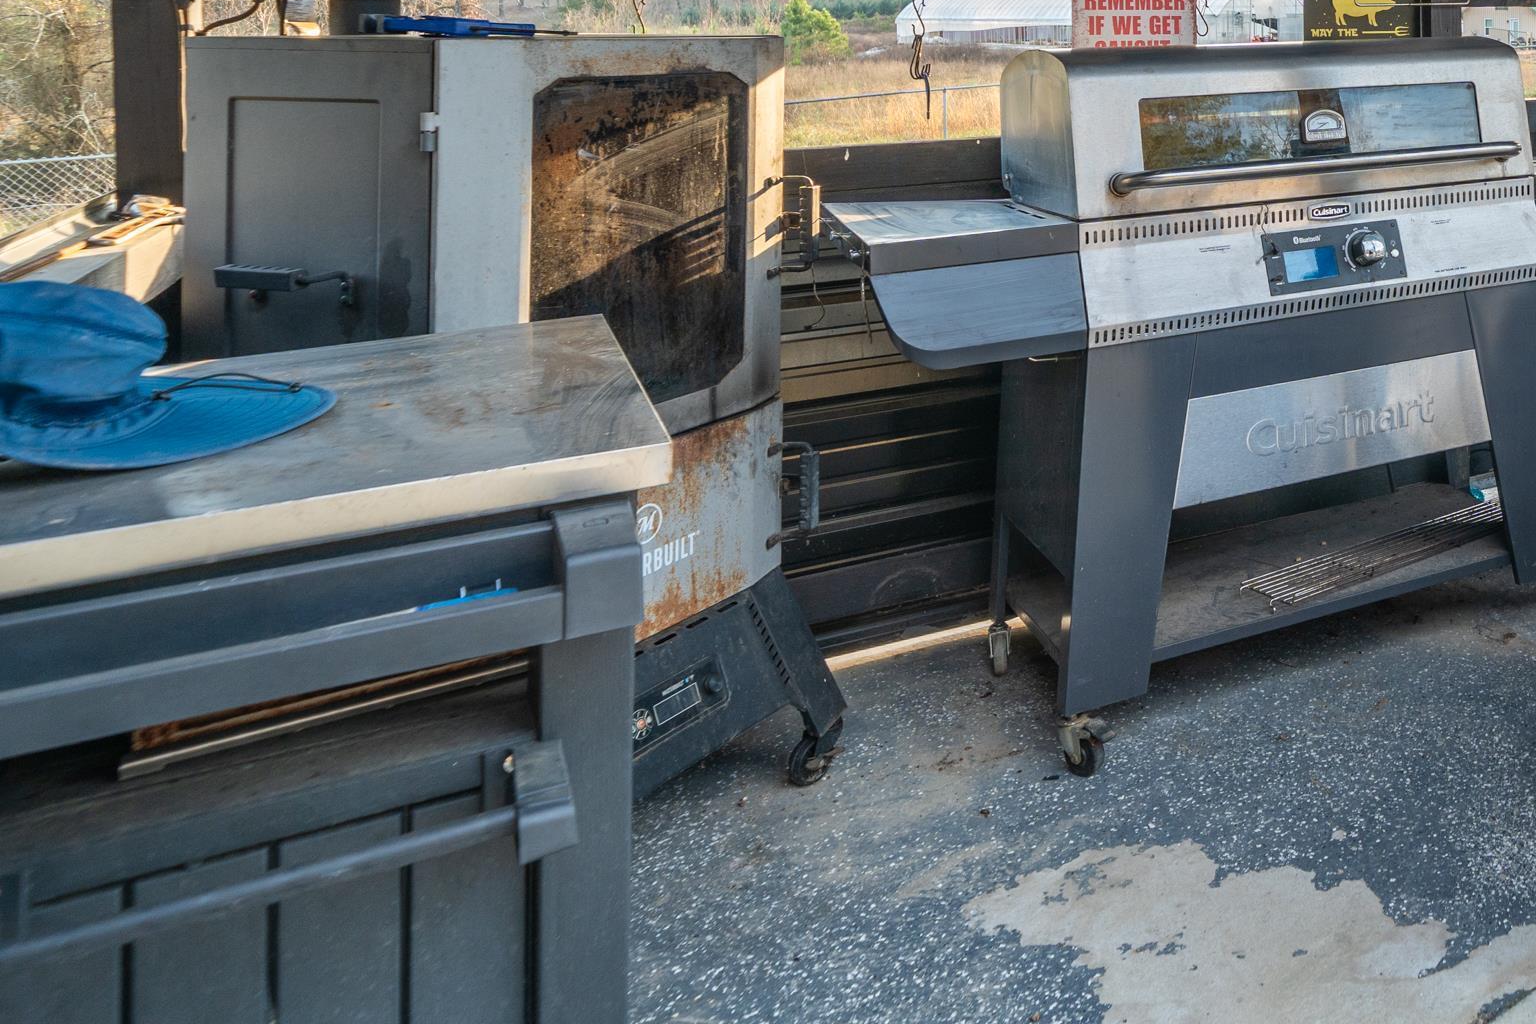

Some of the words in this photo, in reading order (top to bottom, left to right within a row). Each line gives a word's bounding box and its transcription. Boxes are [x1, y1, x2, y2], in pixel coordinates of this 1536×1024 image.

[1088, 16, 1105, 35] IF
[1112, 15, 1142, 35] WE
[1149, 15, 1182, 35] GET
[1311, 29, 1333, 37] MAY
[1337, 28, 1358, 37] THE
[1313, 206, 1348, 216] Cuisinart
[1245, 390, 1436, 456] Cuisinart
[642, 531, 698, 576] RBUILT
